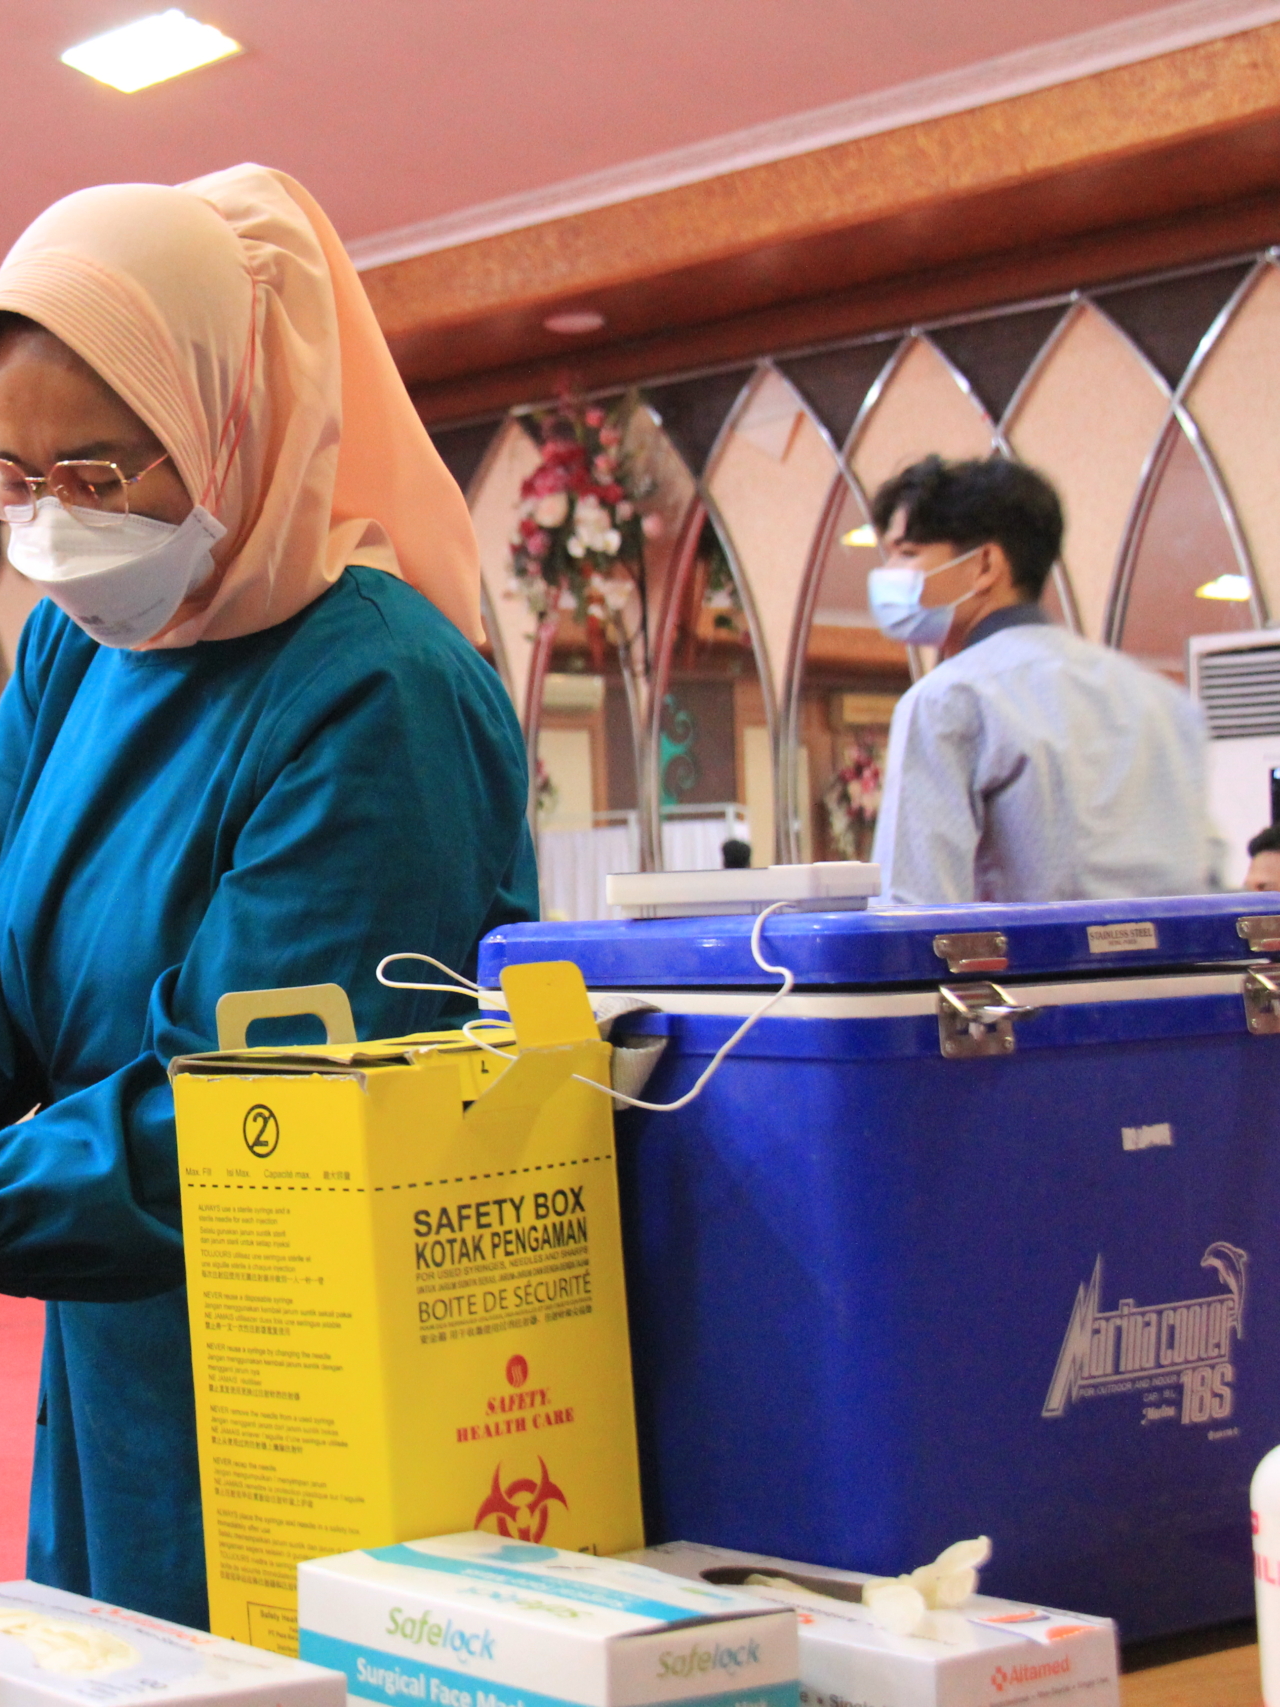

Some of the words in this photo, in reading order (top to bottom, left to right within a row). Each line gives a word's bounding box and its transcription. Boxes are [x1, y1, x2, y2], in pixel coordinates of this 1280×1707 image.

[1090, 930, 1129, 940] STAINLESS
[1130, 928, 1152, 937] STEEL
[413, 1196, 525, 1238] SAFETY
[534, 1185, 586, 1220] BOX
[414, 1233, 486, 1270] KOTAK
[491, 1216, 588, 1259] PENGAMAN
[416, 1271, 434, 1282] FOR
[437, 1268, 461, 1279] USED
[509, 1254, 543, 1267] NEEDLES
[545, 1250, 559, 1260] AND
[561, 1245, 588, 1258] SHARPS
[418, 1294, 478, 1323] BOITE
[483, 1288, 508, 1313] DE
[513, 1269, 592, 1308] SÉCURITÉ
[456, 1417, 526, 1443] HEALTH
[532, 1407, 575, 1429] CARE
[385, 1606, 495, 1661] Safelock
[656, 1637, 760, 1678] Safelock
[1010, 1655, 1070, 1684] Altamed
[356, 1656, 426, 1698] Surgical
[430, 1678, 471, 1707] Face
